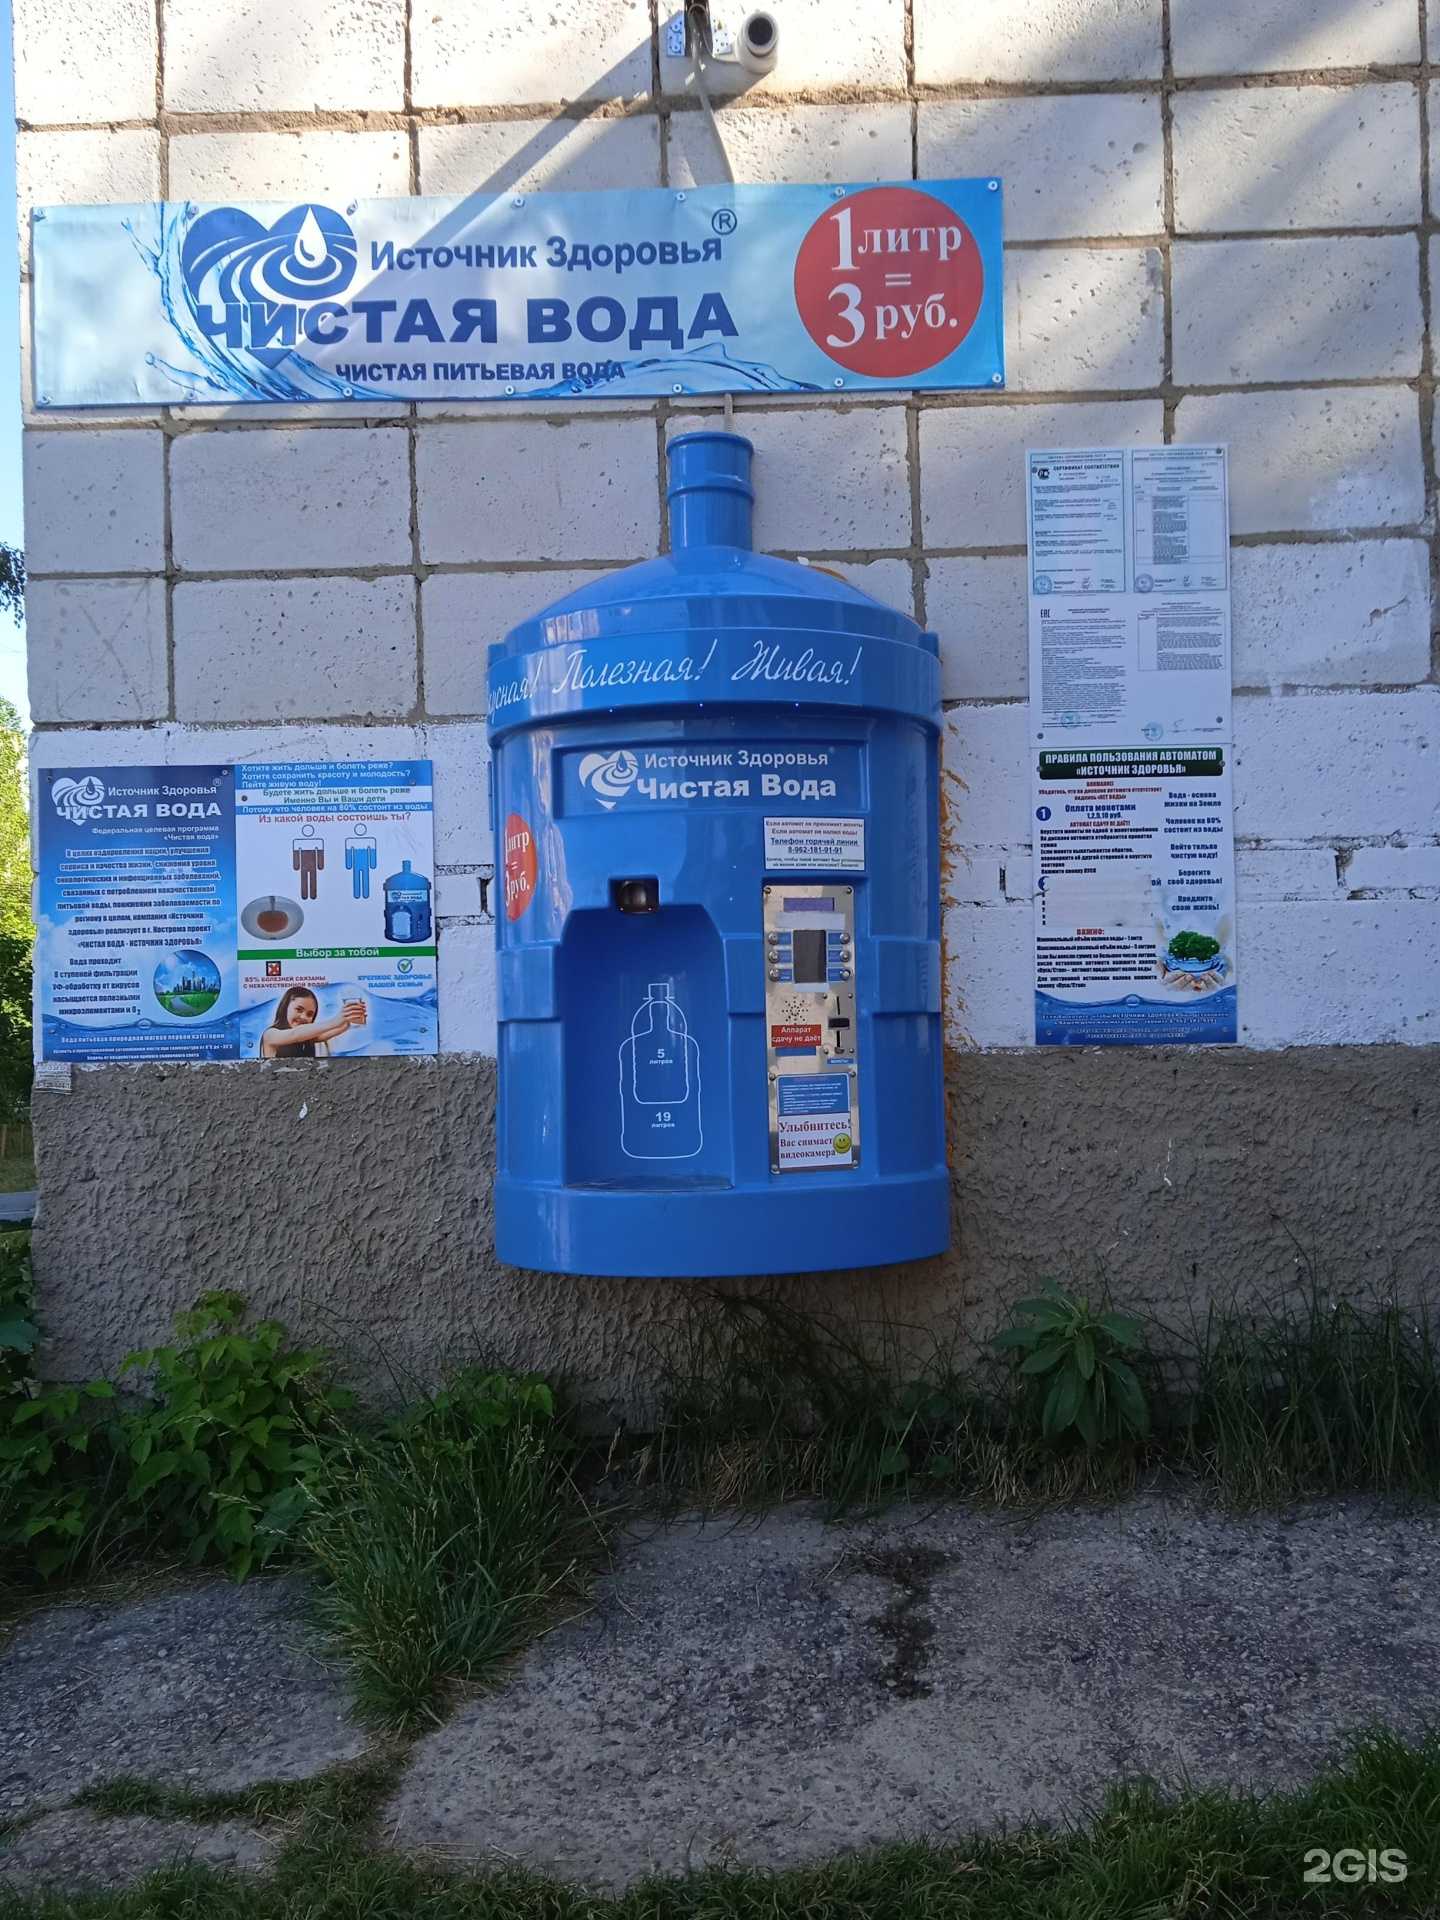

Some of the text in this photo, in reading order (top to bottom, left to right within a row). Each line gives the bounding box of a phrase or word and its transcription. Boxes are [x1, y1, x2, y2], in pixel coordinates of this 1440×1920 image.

[830, 207, 962, 271] 1 литр
[371, 241, 537, 271] Источник
[546, 235, 722, 274] Здоровья
[198, 291, 739, 351] ЧИСТАЯ ВОДА
[826, 282, 958, 348] 3 руб.
[335, 360, 626, 383] ЧИСТАЯ ПИТЬЕВАЯ ВОДА
[551, 638, 718, 694] Полезная!
[731, 638, 864, 686] Живая!
[644, 749, 829, 769] Источник Здоровья
[1045, 750, 1217, 764] ПРАВИЛА ПОЛЬЗОВАНИЯ АВТОМАТОМ
[336, 762, 366, 770] болеть
[1076, 763, 1186, 776] «ИСТОЧНИК ЗДОРОВЬЯ»
[272, 773, 315, 781] сохранить
[318, 772, 351, 780] красоту
[360, 769, 411, 777] молодость?
[108, 785, 217, 796] Источник Здоровья
[263, 789, 293, 797] Будете
[636, 773, 836, 801] Чистая Вода
[283, 796, 316, 804] Именно
[340, 795, 364, 803] Ваши
[366, 795, 386, 803] дети
[56, 802, 222, 820] ЧИСТАЯ ВОДА
[242, 806, 273, 815] Потому
[358, 803, 392, 811] состоит
[1064, 803, 1136, 813] Оплата монетами
[258, 811, 412, 823] Из какой воды состоишь ты?
[178, 825, 219, 833] программа
[770, 837, 804, 846] Телефон
[805, 838, 835, 847] горячей
[296, 948, 380, 958] Выбор за тобой
[781, 1026, 811, 1034] Аппарат
[657, 1048, 665, 1059] 5
[655, 1111, 671, 1122] 19
[780, 1137, 832, 1148] Вас снимает
[780, 1149, 836, 1159] видеокамера
